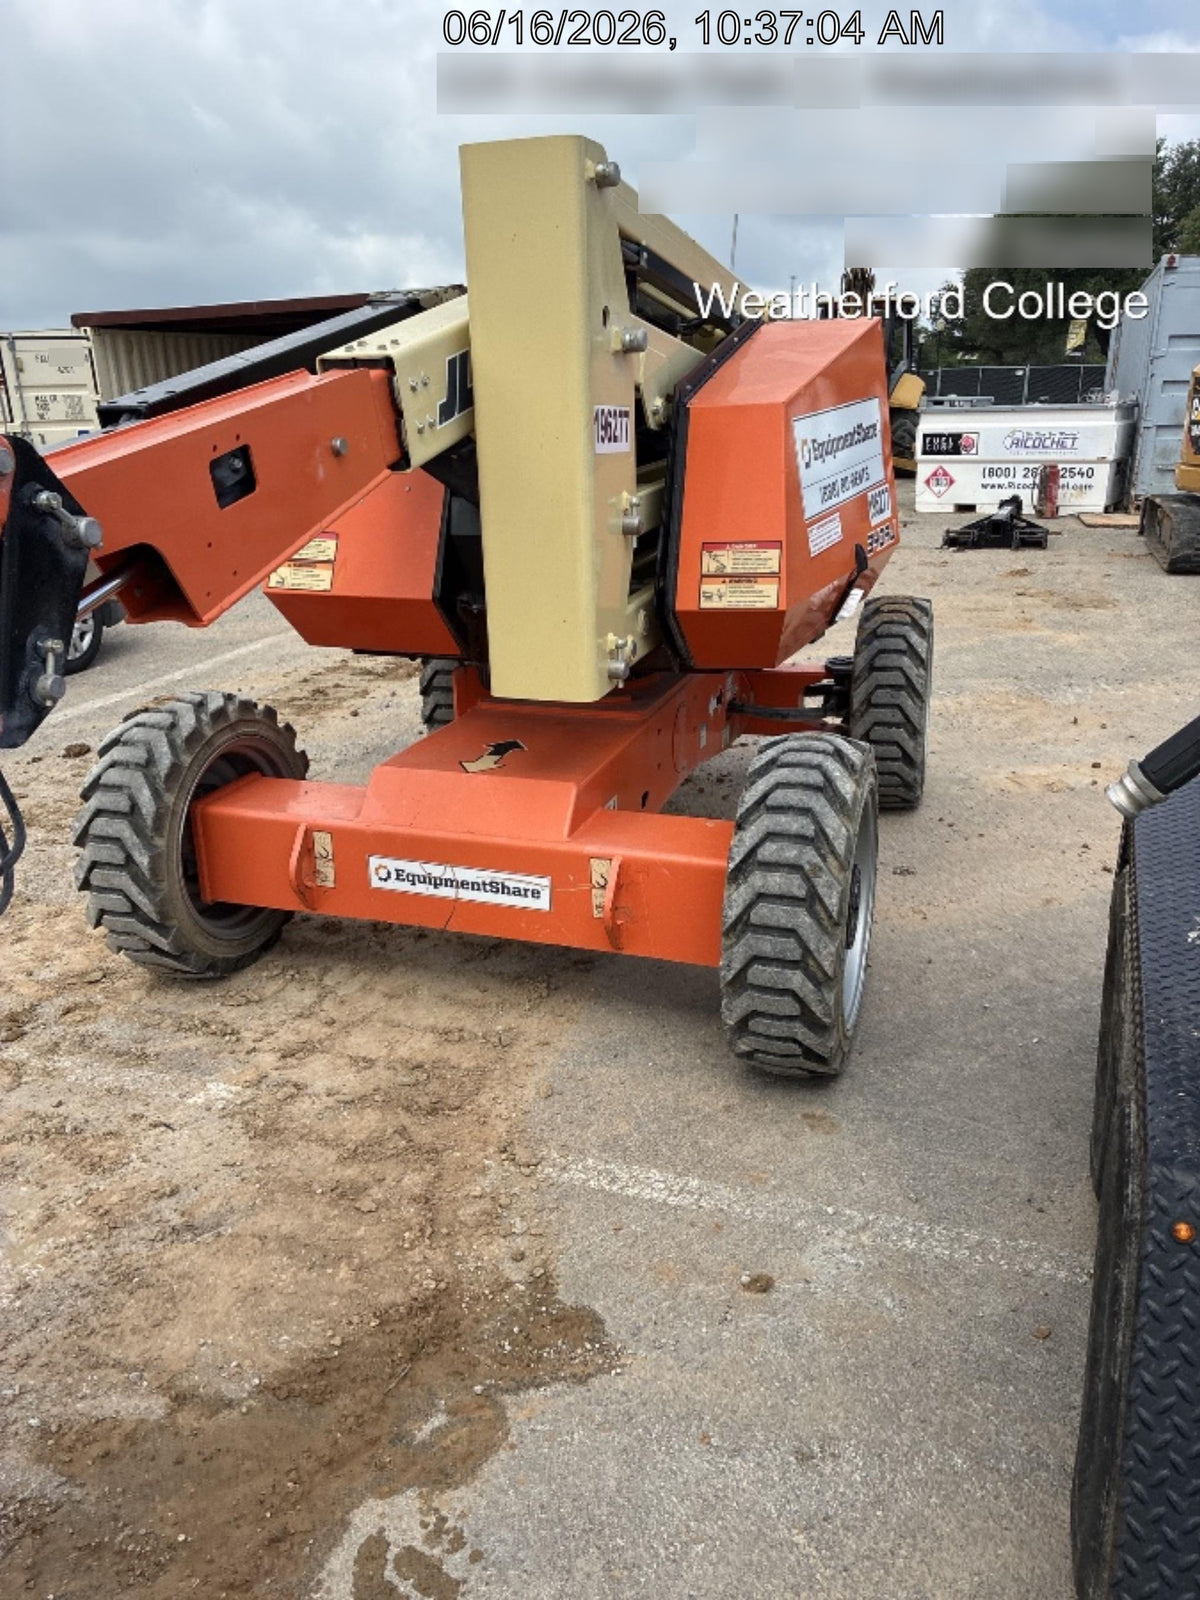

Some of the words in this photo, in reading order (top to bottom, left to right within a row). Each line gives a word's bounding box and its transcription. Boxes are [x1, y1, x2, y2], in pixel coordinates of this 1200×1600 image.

[437, 348, 475, 429] JL
[982, 467, 1016, 479] (800)
[394, 868, 542, 899] EquipmentShare
